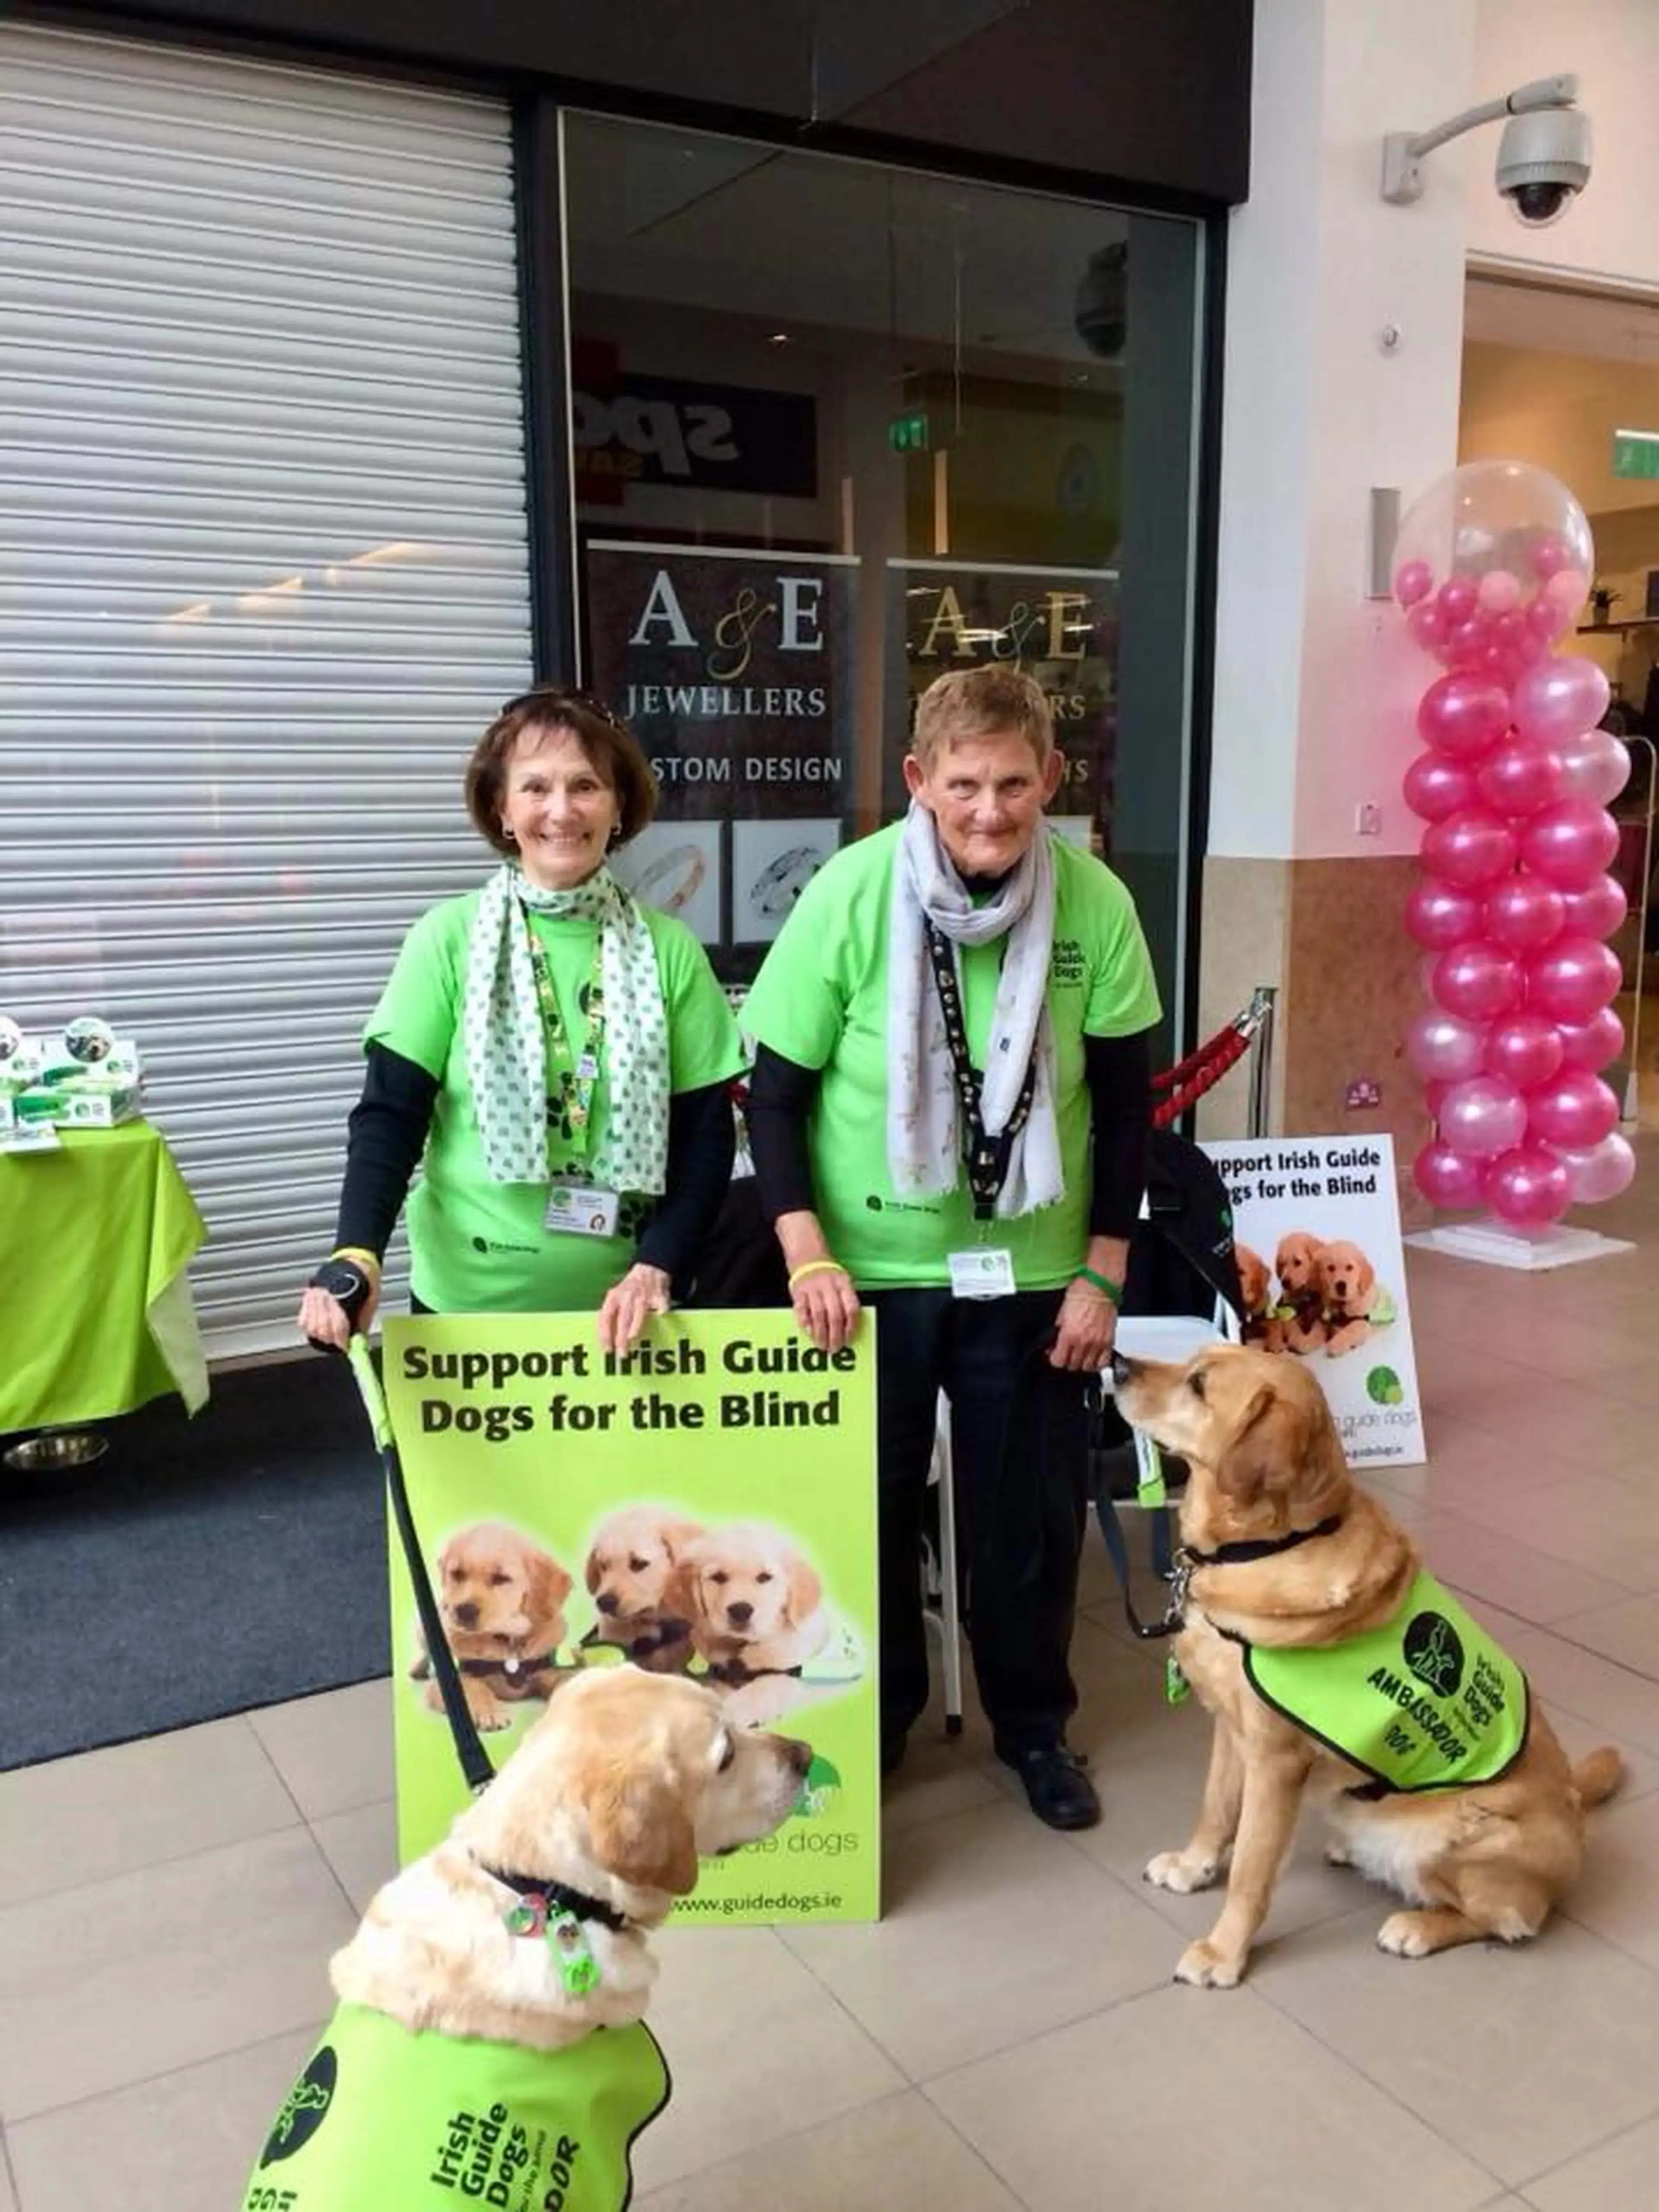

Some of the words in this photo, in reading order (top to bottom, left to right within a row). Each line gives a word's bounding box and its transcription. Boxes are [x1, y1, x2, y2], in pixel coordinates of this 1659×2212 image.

[628, 570, 699, 646] A
[706, 588, 777, 680] &
[775, 577, 823, 651] E
[918, 585, 978, 657] A
[1045, 591, 1087, 661] E
[625, 684, 826, 721] JEWELLERS
[650, 756, 730, 782] STOM
[746, 756, 842, 782] DESIGN
[1212, 1154, 1273, 1179] pport
[1278, 1151, 1320, 1171] Irish
[1326, 1148, 1381, 1167] Guide
[1230, 1185, 1252, 1205] gs
[1258, 1179, 1286, 1198] for
[1290, 1177, 1322, 1197] the
[1327, 1174, 1377, 1195] Blind
[404, 1344, 589, 1389] Support
[605, 1338, 706, 1376] Irish
[723, 1337, 856, 1373] Guide
[422, 1399, 535, 1442] Dogs
[549, 1394, 617, 1430] for
[631, 1393, 704, 1430] the
[721, 1389, 840, 1427] Blind
[788, 1828, 860, 1856] dogs
[430, 2111, 476, 2188] Irish
[460, 2102, 508, 2196] Guide
[486, 2123, 529, 2209] Dogs
[544, 2134, 581, 2212] DOR
